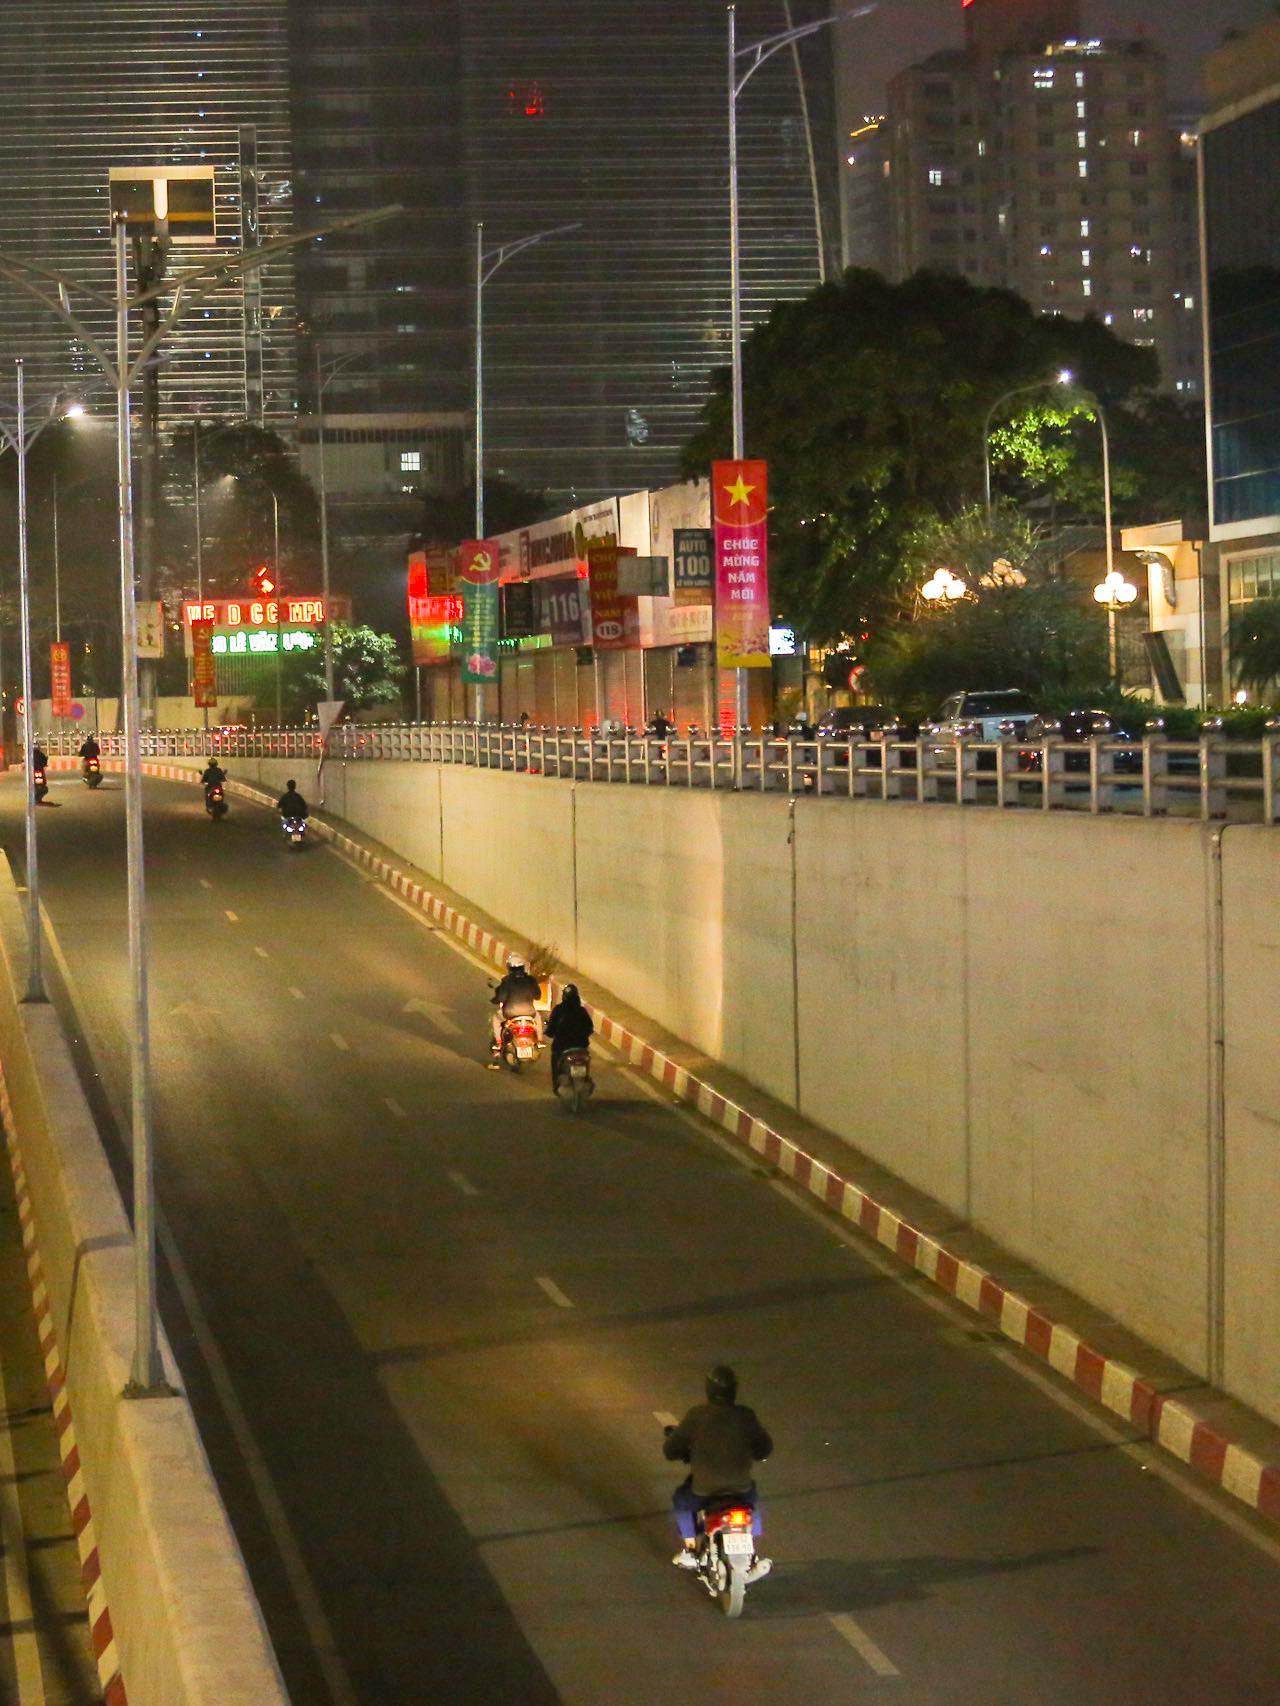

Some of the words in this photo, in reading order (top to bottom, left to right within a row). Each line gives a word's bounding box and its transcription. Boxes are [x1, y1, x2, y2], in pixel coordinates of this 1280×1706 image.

[723, 537, 759, 550] CHÚC
[676, 555, 710, 577] 100
[728, 570, 755, 583] NĂM
[550, 593, 578, 622] 116
[600, 624, 619, 636] 118
